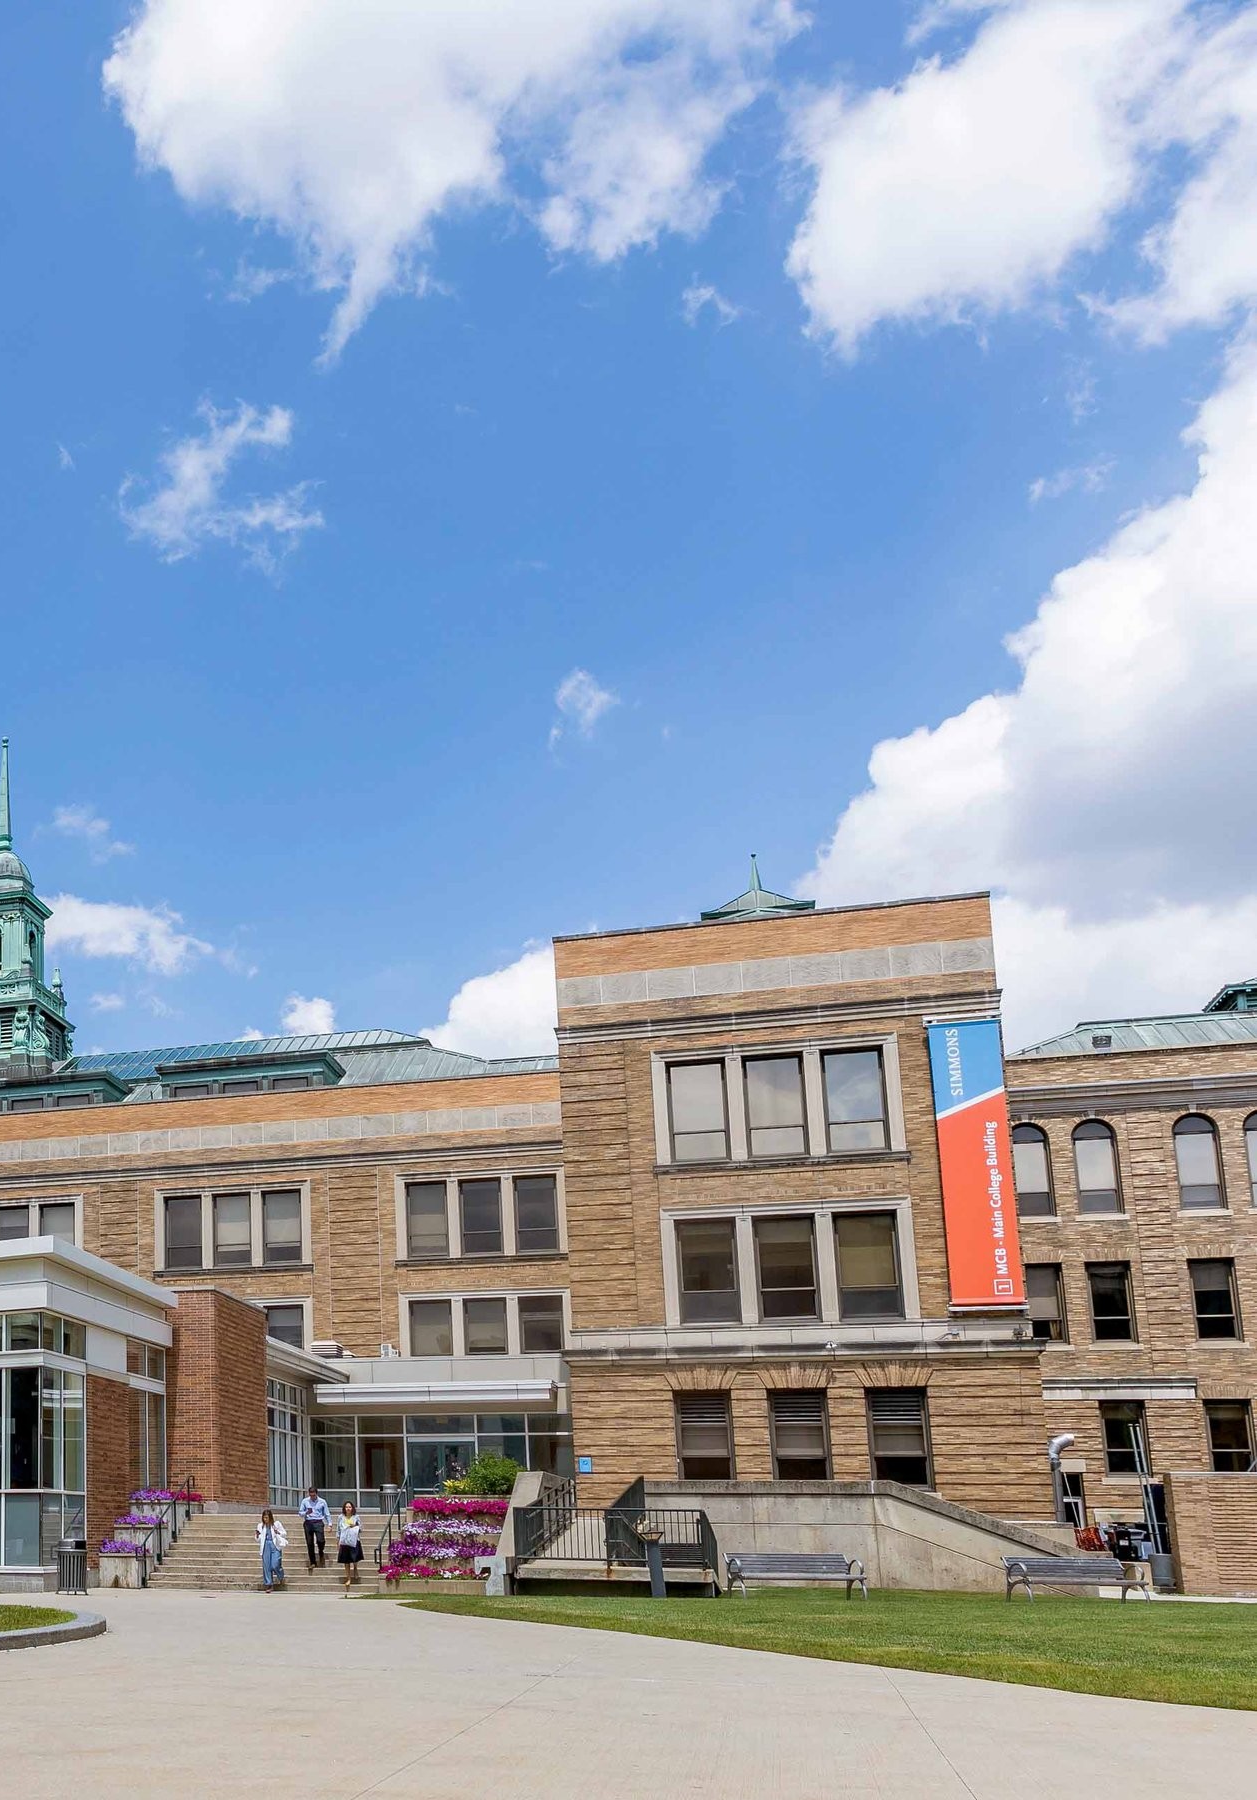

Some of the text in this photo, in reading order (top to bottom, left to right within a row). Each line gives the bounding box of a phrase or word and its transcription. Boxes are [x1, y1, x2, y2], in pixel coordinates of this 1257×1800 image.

[945, 1029, 963, 1096] SIMMONS
[983, 1121, 998, 1166] Building
[988, 1168, 1003, 1208] College
[991, 1210, 1005, 1237] Main
[995, 1248, 1008, 1275] MCB
